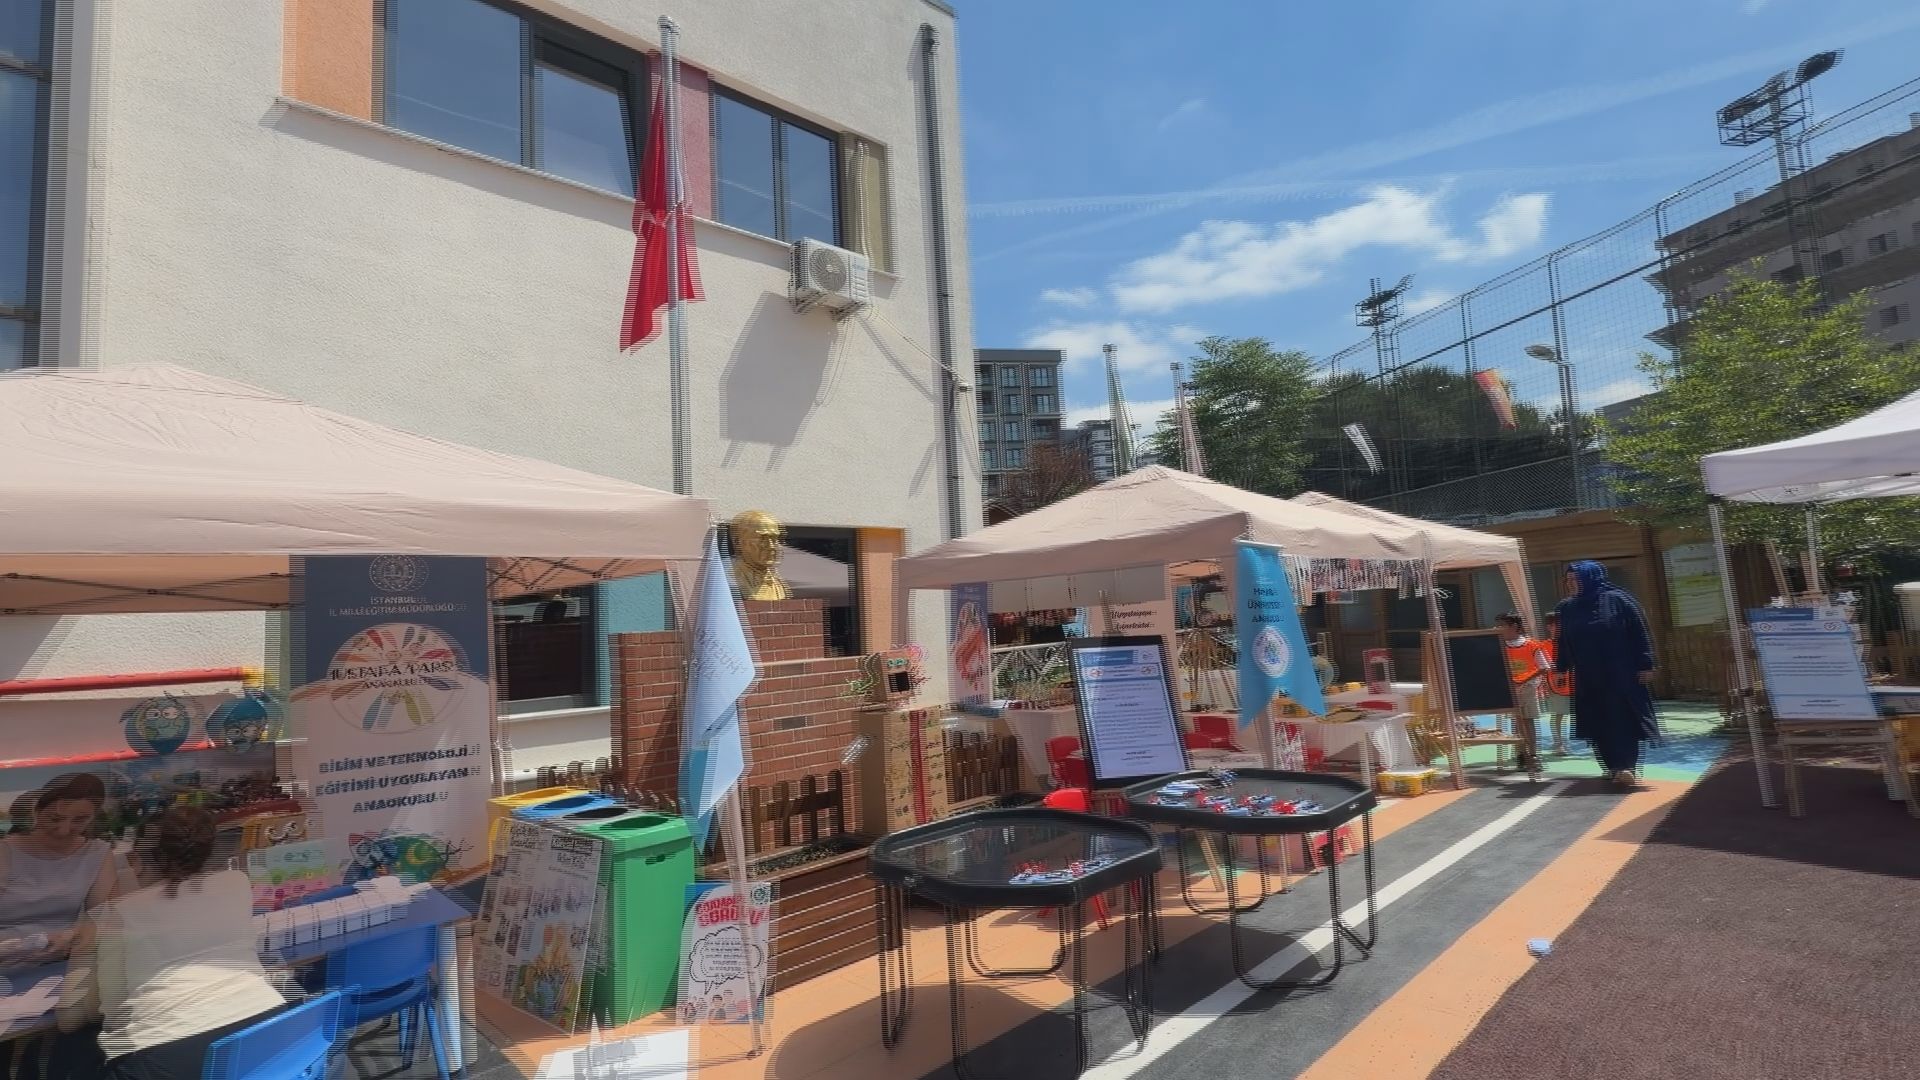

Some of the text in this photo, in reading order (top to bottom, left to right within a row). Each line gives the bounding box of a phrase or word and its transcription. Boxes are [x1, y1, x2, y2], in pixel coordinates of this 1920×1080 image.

[319, 744, 468, 774] BİLİM VE TEKNOLOJİ
[315, 767, 469, 797] EĞİTİMİ UYGULAYAN
[352, 791, 437, 814] ANAOKULU
